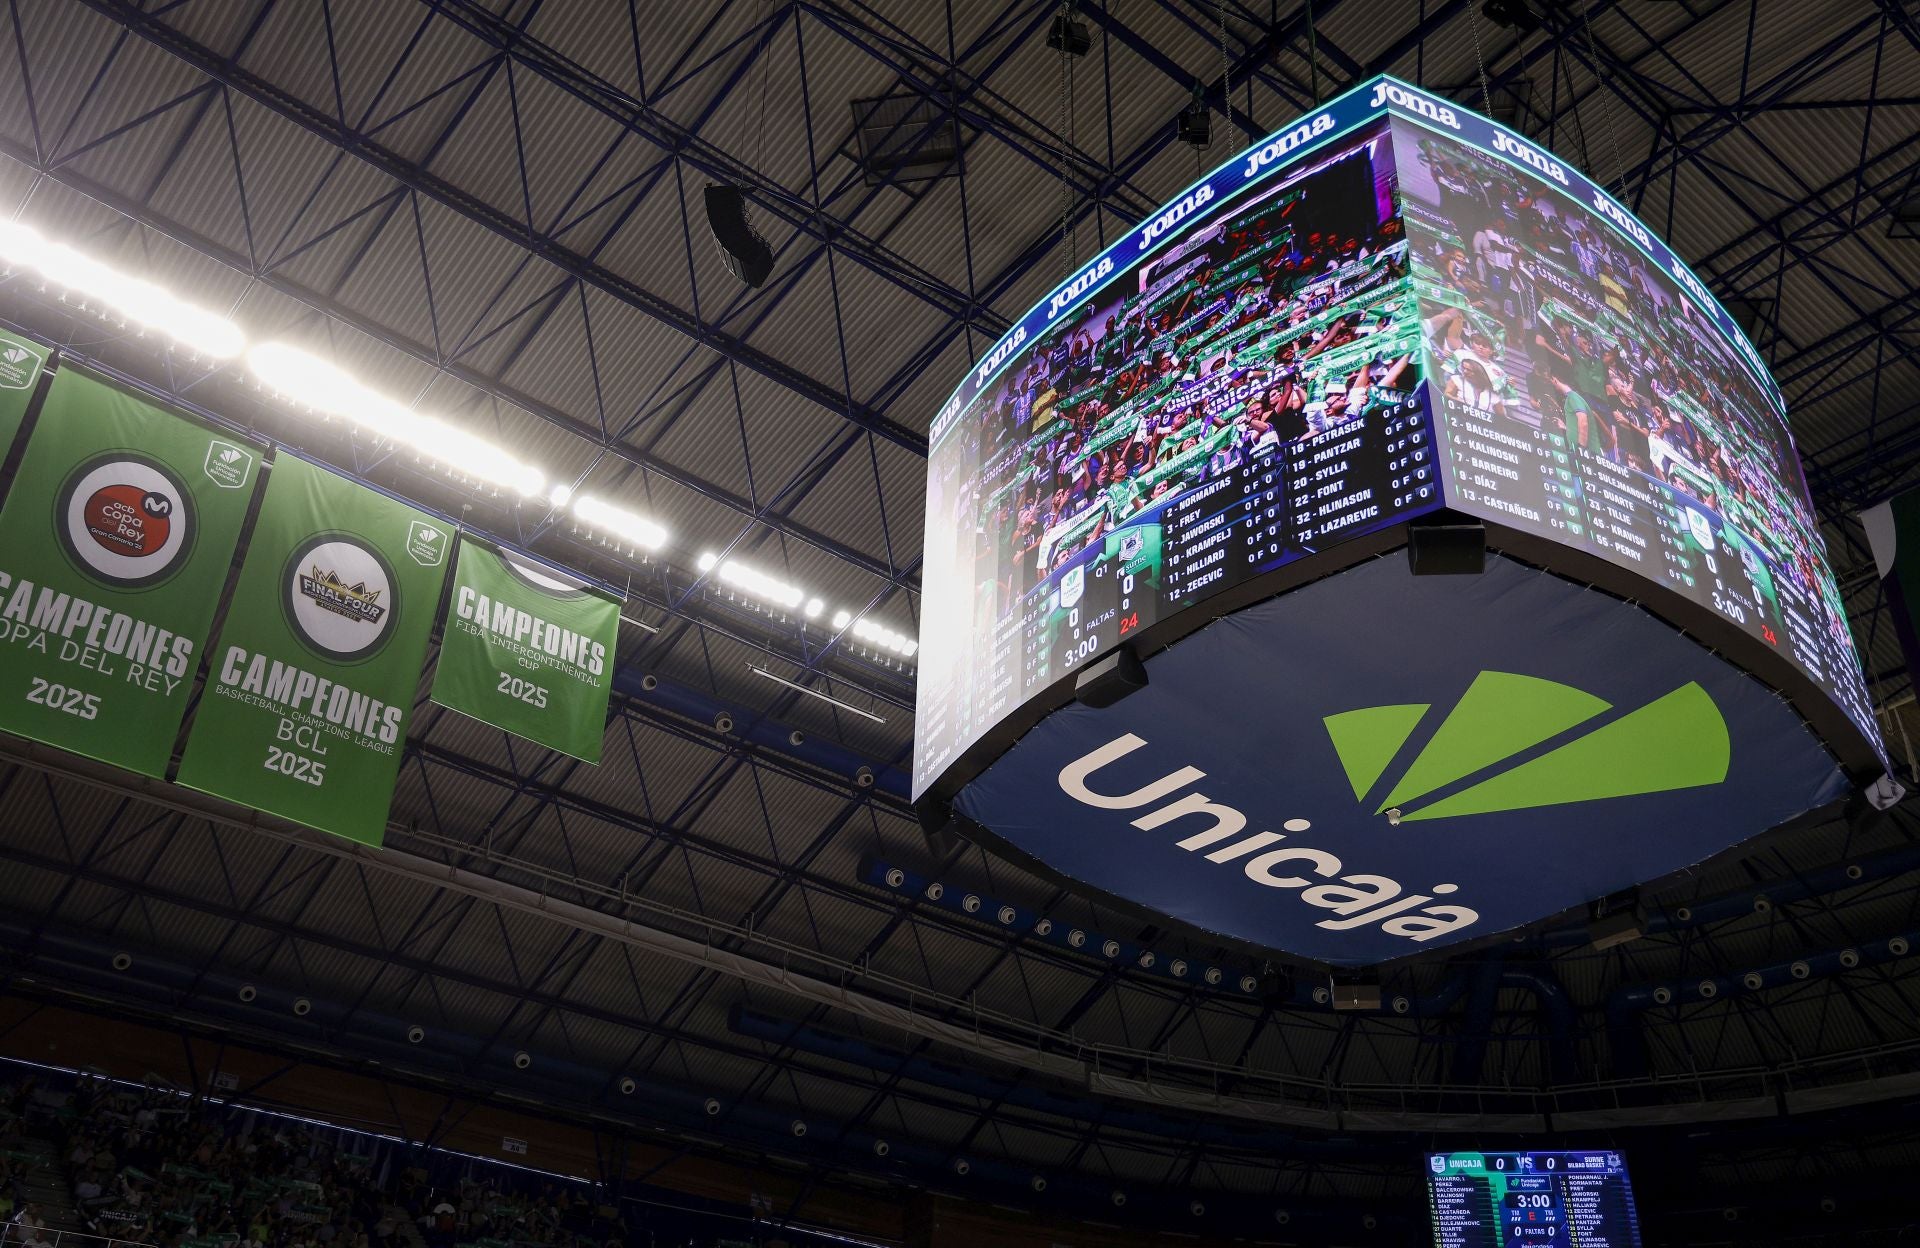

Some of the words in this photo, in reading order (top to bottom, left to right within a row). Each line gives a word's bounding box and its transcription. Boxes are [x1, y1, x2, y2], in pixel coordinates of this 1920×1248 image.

[1370, 82, 1461, 130] Joma
[1243, 111, 1335, 178] Joma
[1492, 129, 1569, 186] Joma
[1138, 184, 1214, 250] Joma
[1593, 190, 1652, 251] Joma
[1047, 257, 1113, 319] Joma
[1671, 259, 1718, 319] Joma
[975, 324, 1026, 388] Joma
[929, 395, 961, 443] oma
[1312, 419, 1365, 447] PETRASEK
[1451, 417, 1457, 427] 2
[1466, 422, 1532, 453] BALCEROWSKI
[1293, 460, 1305, 472] 19
[1314, 438, 1360, 464] PANTZAR
[1454, 435, 1460, 444] 4
[1294, 477, 1307, 490] 20
[1316, 461, 1348, 481] SYLLA
[1456, 452, 1462, 462] 7
[1472, 457, 1519, 480] BARREIRO
[113, 502, 135, 513] acb
[1167, 508, 1172, 518] 2
[1180, 477, 1231, 510] NORMANTAS
[1295, 494, 1308, 507] 22
[1317, 480, 1344, 498] FONT
[1296, 512, 1310, 525] 32
[1319, 489, 1371, 516] HLINASON
[1463, 488, 1475, 501] 13
[1484, 495, 1540, 521] CASTAÑEDA
[1585, 481, 1596, 493] 27
[1603, 489, 1635, 511] DUARTE
[102, 505, 143, 528] Copa
[117, 523, 145, 541] Rey
[1168, 524, 1173, 534] 3
[1180, 509, 1200, 527] FREY
[1168, 541, 1173, 550] 7
[1180, 514, 1224, 544] JAWORSKI
[1298, 529, 1312, 543] 73
[1321, 506, 1378, 535] LAZAREVIC
[1607, 506, 1632, 526] TILLIE
[90, 527, 109, 540] Gran
[1169, 555, 1179, 567] 10
[1186, 528, 1231, 558] KRAMPELJ
[1596, 534, 1609, 547] 55
[1614, 542, 1641, 562] PERRY
[1096, 564, 1108, 578] Q1
[1169, 572, 1178, 583] 11
[1187, 549, 1224, 575] HILLIARD
[1705, 553, 1717, 574] 0
[304, 579, 342, 602] FINAL
[344, 595, 380, 617] FOUR
[1123, 574, 1134, 595] 0
[1170, 589, 1180, 601] 12
[1187, 568, 1222, 593] ZECEVIC
[1716, 578, 1723, 590] 0
[1728, 587, 1753, 610] FALTAS
[1752, 585, 1763, 605] 0
[1069, 608, 1079, 628] 0
[1086, 608, 1115, 631] FALTAS
[1123, 598, 1130, 610] 0
[1712, 591, 1744, 624] 3:00
[456, 586, 605, 676] CAMPEONES
[1073, 628, 1080, 640] 0
[1120, 612, 1138, 635] 24
[1762, 624, 1777, 646] 24
[0, 618, 47, 654] OPA
[60, 640, 114, 676] DEL
[127, 663, 181, 696] REY
[456, 620, 485, 639] FIBA
[491, 635, 601, 688] INTERCONTINENTAL
[518, 657, 540, 671] CUP
[1065, 635, 1097, 667] 3:00
[26, 677, 101, 720] 2025
[220, 645, 402, 744] CAMPEONES
[497, 671, 549, 709] 2025
[215, 684, 286, 716] BASKETBALL
[291, 711, 351, 740] CHAMPIONS
[354, 734, 394, 756] LEAGUE
[276, 717, 328, 755] BCL
[264, 745, 326, 786] 2025
[1058, 732, 1479, 941] Unicaja
[1449, 1160, 1482, 1168] UNICAJA
[1496, 1158, 1504, 1170] 0
[1516, 1157, 1533, 1169] VS
[1547, 1157, 1555, 1169] 0
[1517, 1194, 1550, 1208] 3:00
[1528, 1211, 1536, 1221] E
[1514, 1226, 1521, 1236] 0
[1548, 1226, 1555, 1236] 0
